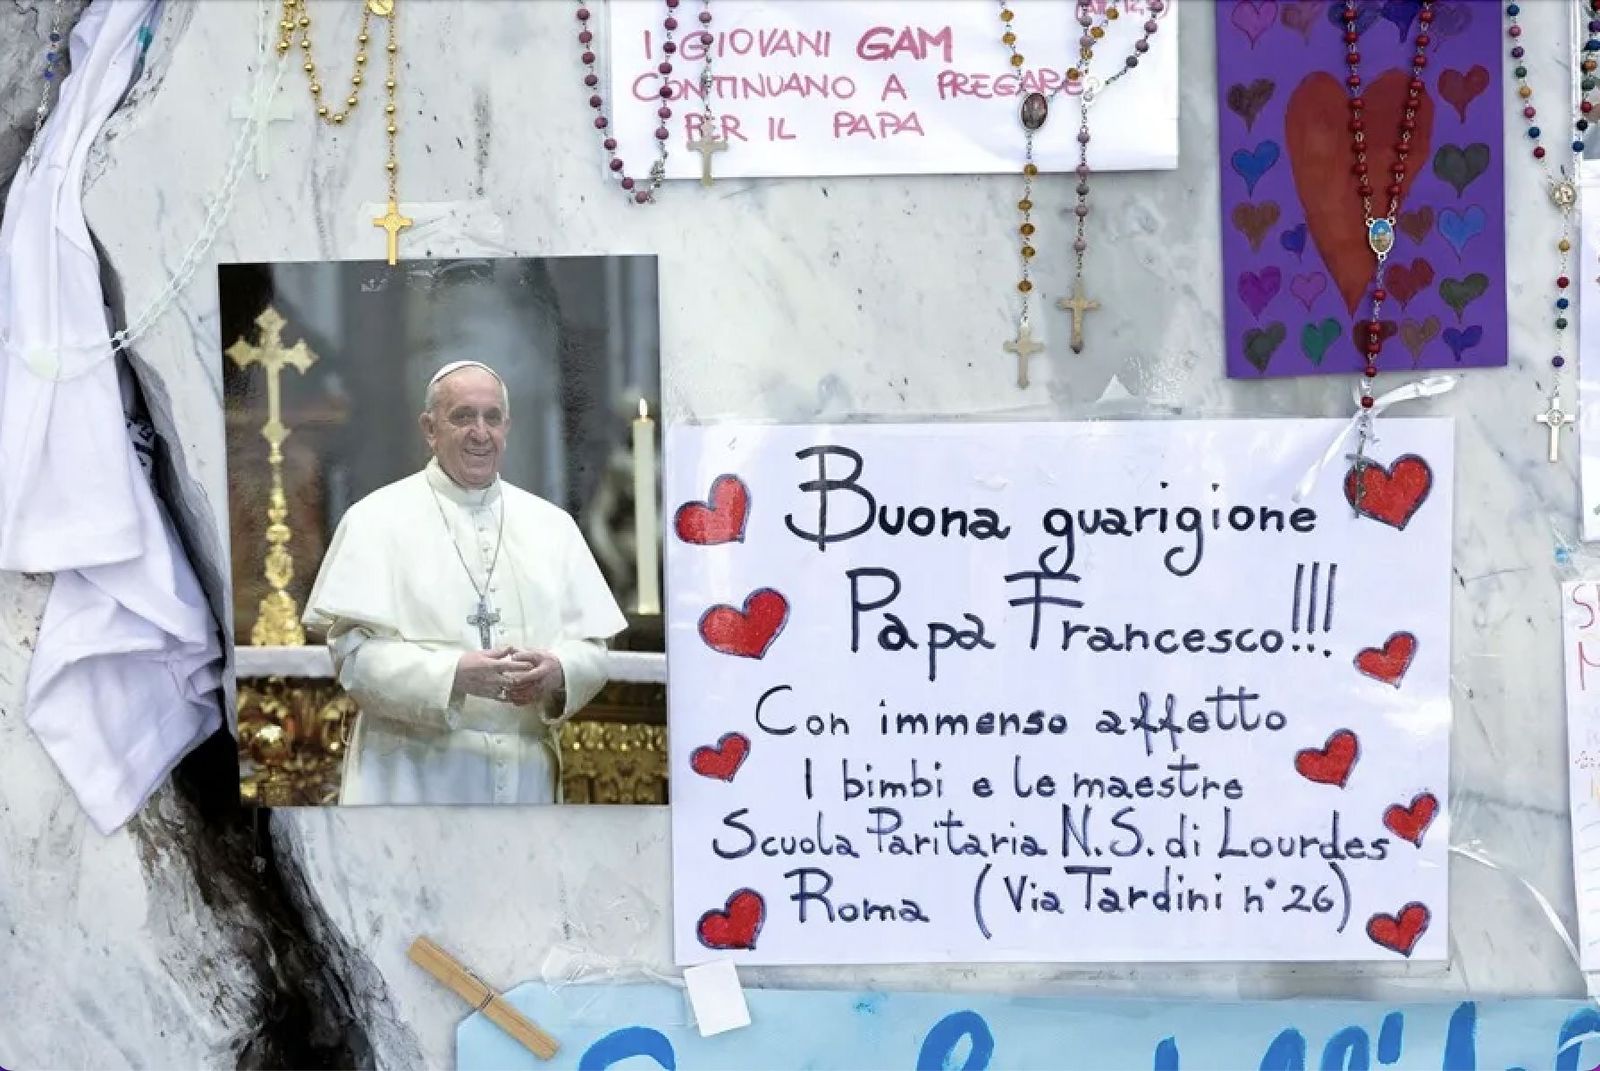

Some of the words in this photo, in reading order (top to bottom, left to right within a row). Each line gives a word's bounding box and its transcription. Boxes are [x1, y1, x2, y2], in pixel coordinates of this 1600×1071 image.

[643, 29, 652, 60] I
[679, 28, 831, 61] GIOVANI
[856, 26, 954, 63] GAM
[881, 73, 908, 102] A
[768, 116, 797, 142] IL
[832, 110, 925, 140] PAPA
[784, 445, 1011, 552] Buona
[1038, 482, 1318, 577] guarigione
[845, 567, 996, 682] Papa
[1004, 561, 1338, 659] Francesco!!!
[755, 684, 850, 736] Con
[879, 698, 1068, 736] immenso
[1095, 686, 1287, 757] affetto
[804, 757, 814, 800] I
[842, 757, 943, 801] bimbi
[972, 776, 994, 799] e
[1014, 755, 1056, 798] le
[1073, 754, 1244, 800] maestre
[712, 807, 861, 859] Scuola
[866, 806, 1048, 858] Paritaria
[1217, 806, 1390, 861] Lourdes
[784, 868, 930, 924] Roma
[974, 863, 1064, 940] (Via
[1063, 865, 1222, 913] Tardini
